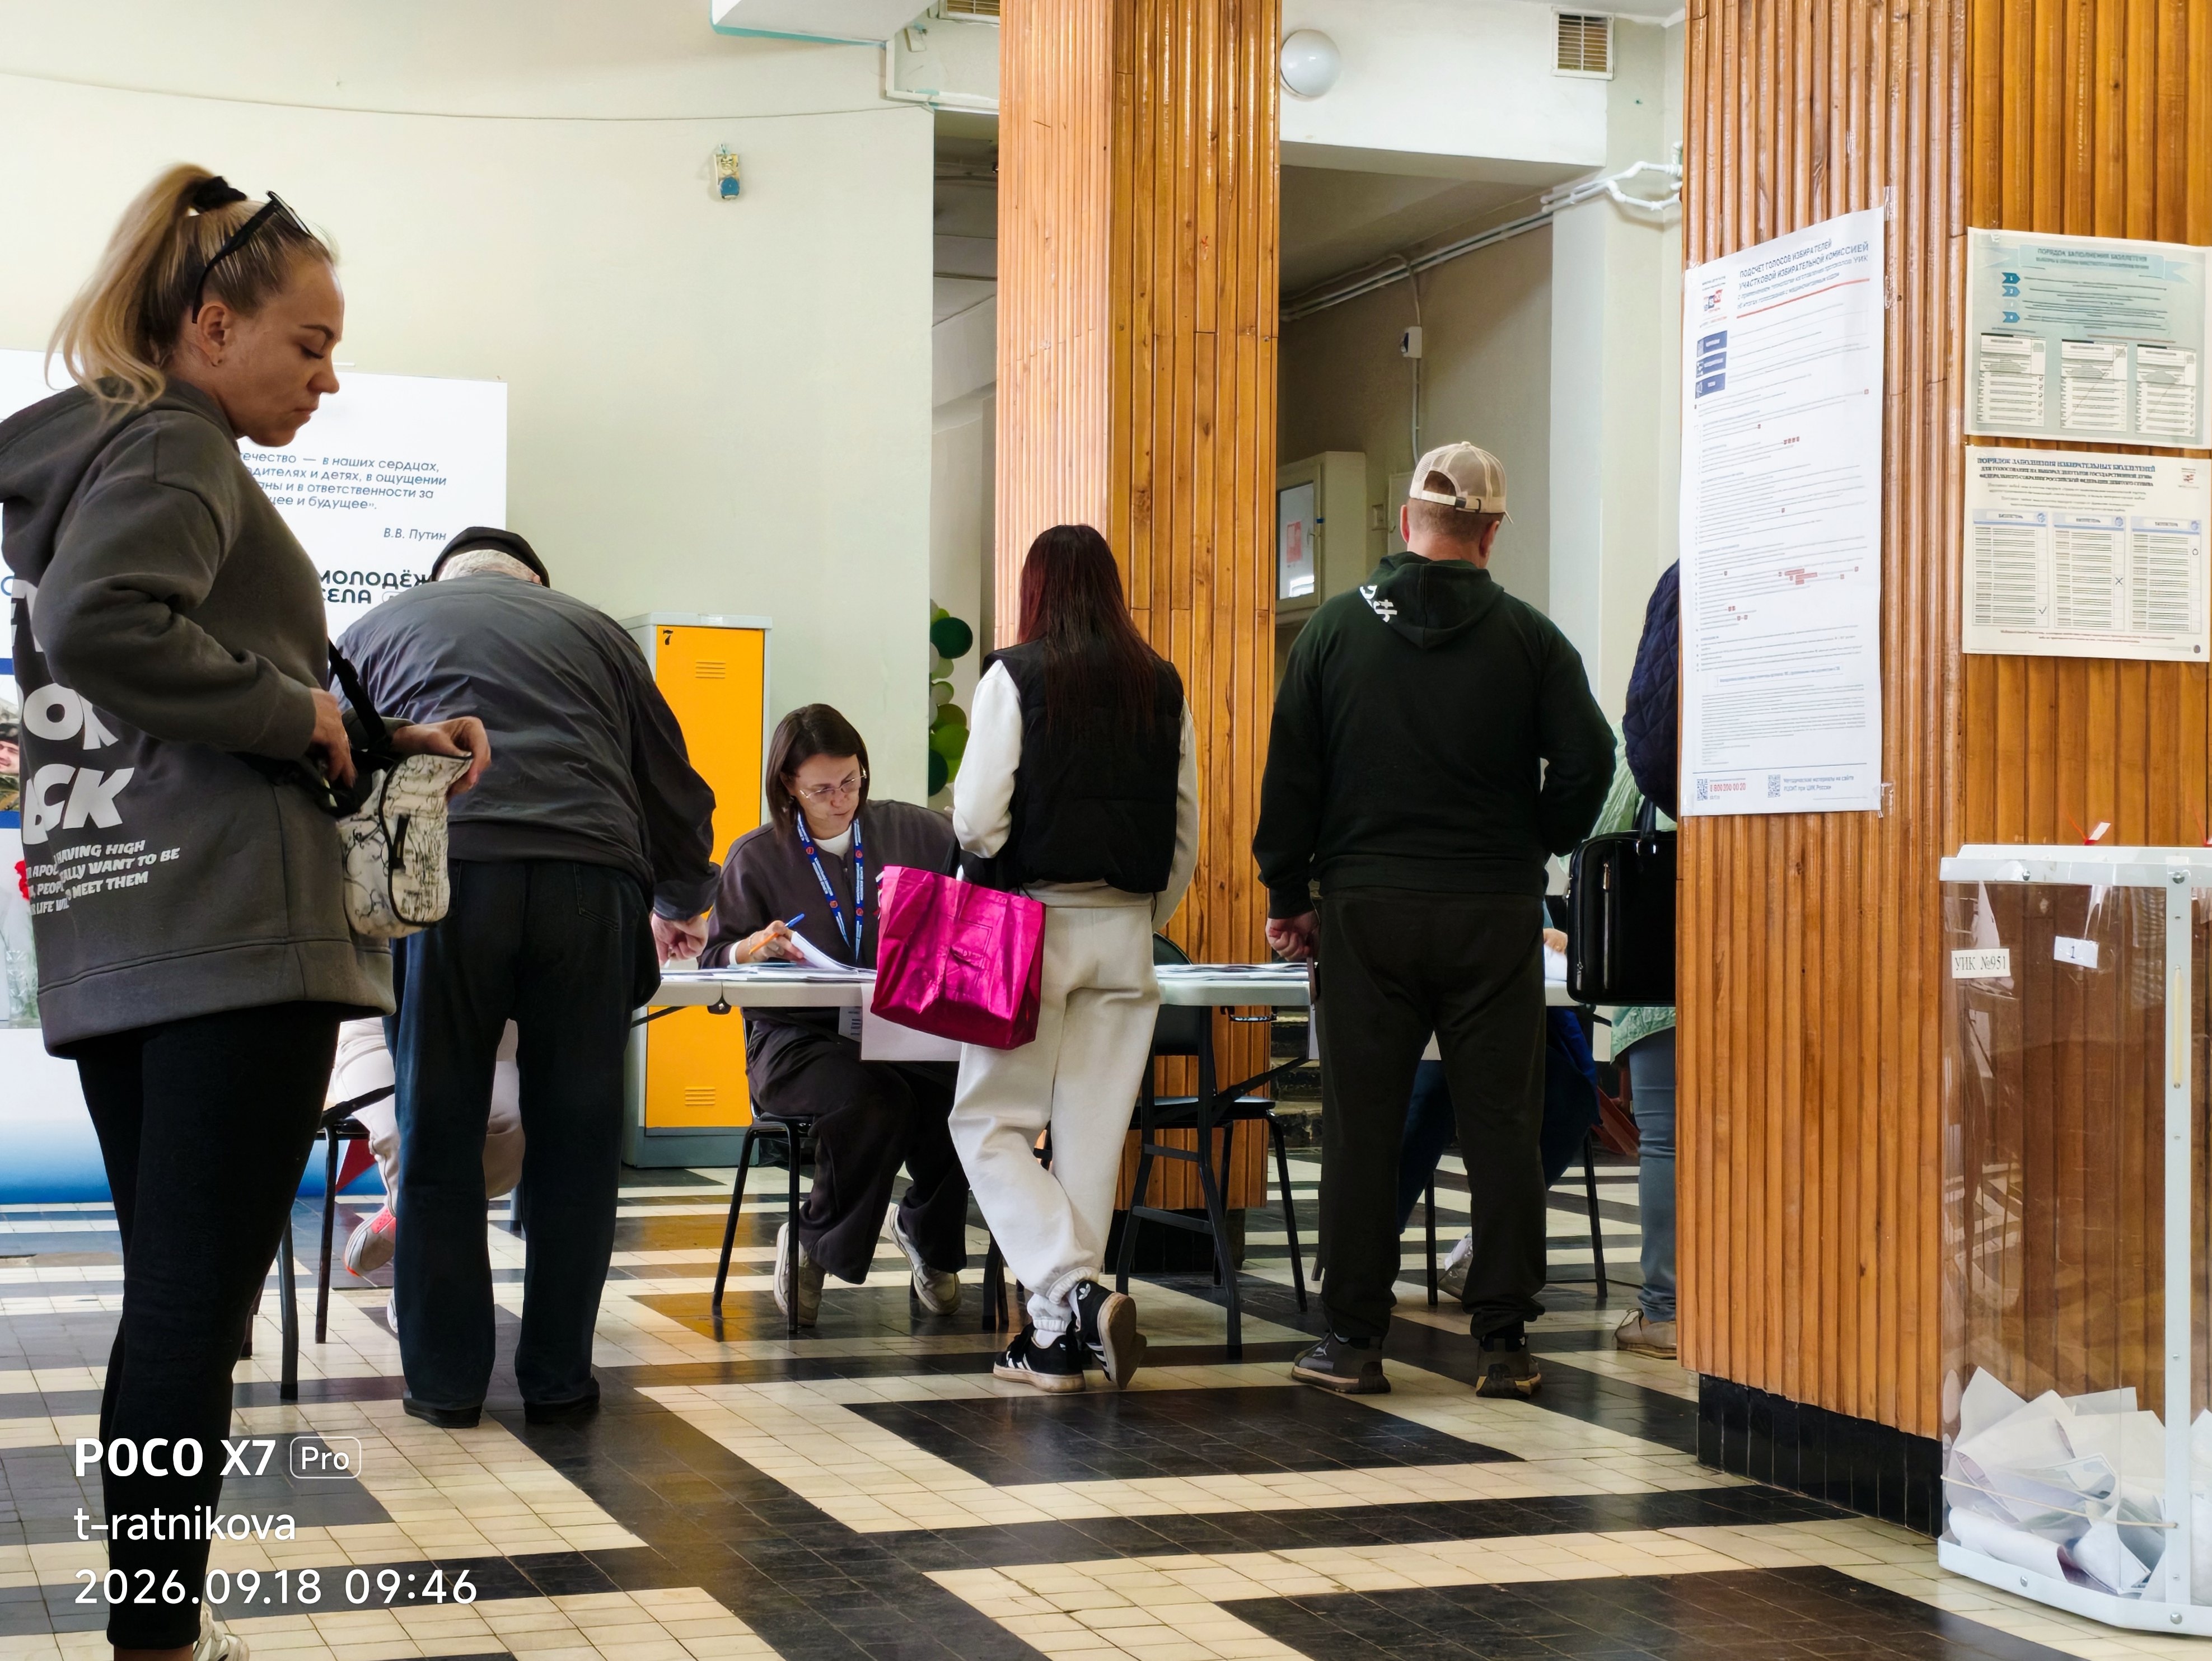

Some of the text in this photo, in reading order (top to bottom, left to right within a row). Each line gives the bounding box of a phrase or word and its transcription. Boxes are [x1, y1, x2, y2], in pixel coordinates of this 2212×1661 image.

[241, 453, 297, 463] ечество
[332, 458, 376, 468] наших
[378, 460, 439, 472] сердцах,
[321, 471, 362, 482] детях,
[376, 474, 447, 485] ощущении
[307, 484, 416, 498] ответственности
[419, 490, 434, 498] за
[297, 498, 305, 506] и
[409, 529, 447, 541] Путин
[320, 569, 432, 589] МОЛОДЁЖ
[322, 588, 372, 604] ЕЛА
[663, 629, 674, 645] 7
[33, 864, 59, 879] APOL
[57, 844, 102, 864] HAVING
[105, 840, 146, 855] HIGH
[88, 858, 135, 874] WANT
[138, 853, 157, 867] TO
[160, 848, 181, 862] BE
[36, 901, 55, 915] LIFE
[56, 898, 70, 911] WIL
[72, 879, 104, 899] MEET
[106, 871, 149, 890] THEM
[2070, 946, 2075, 958] 1
[1980, 956, 2006, 970] №951
